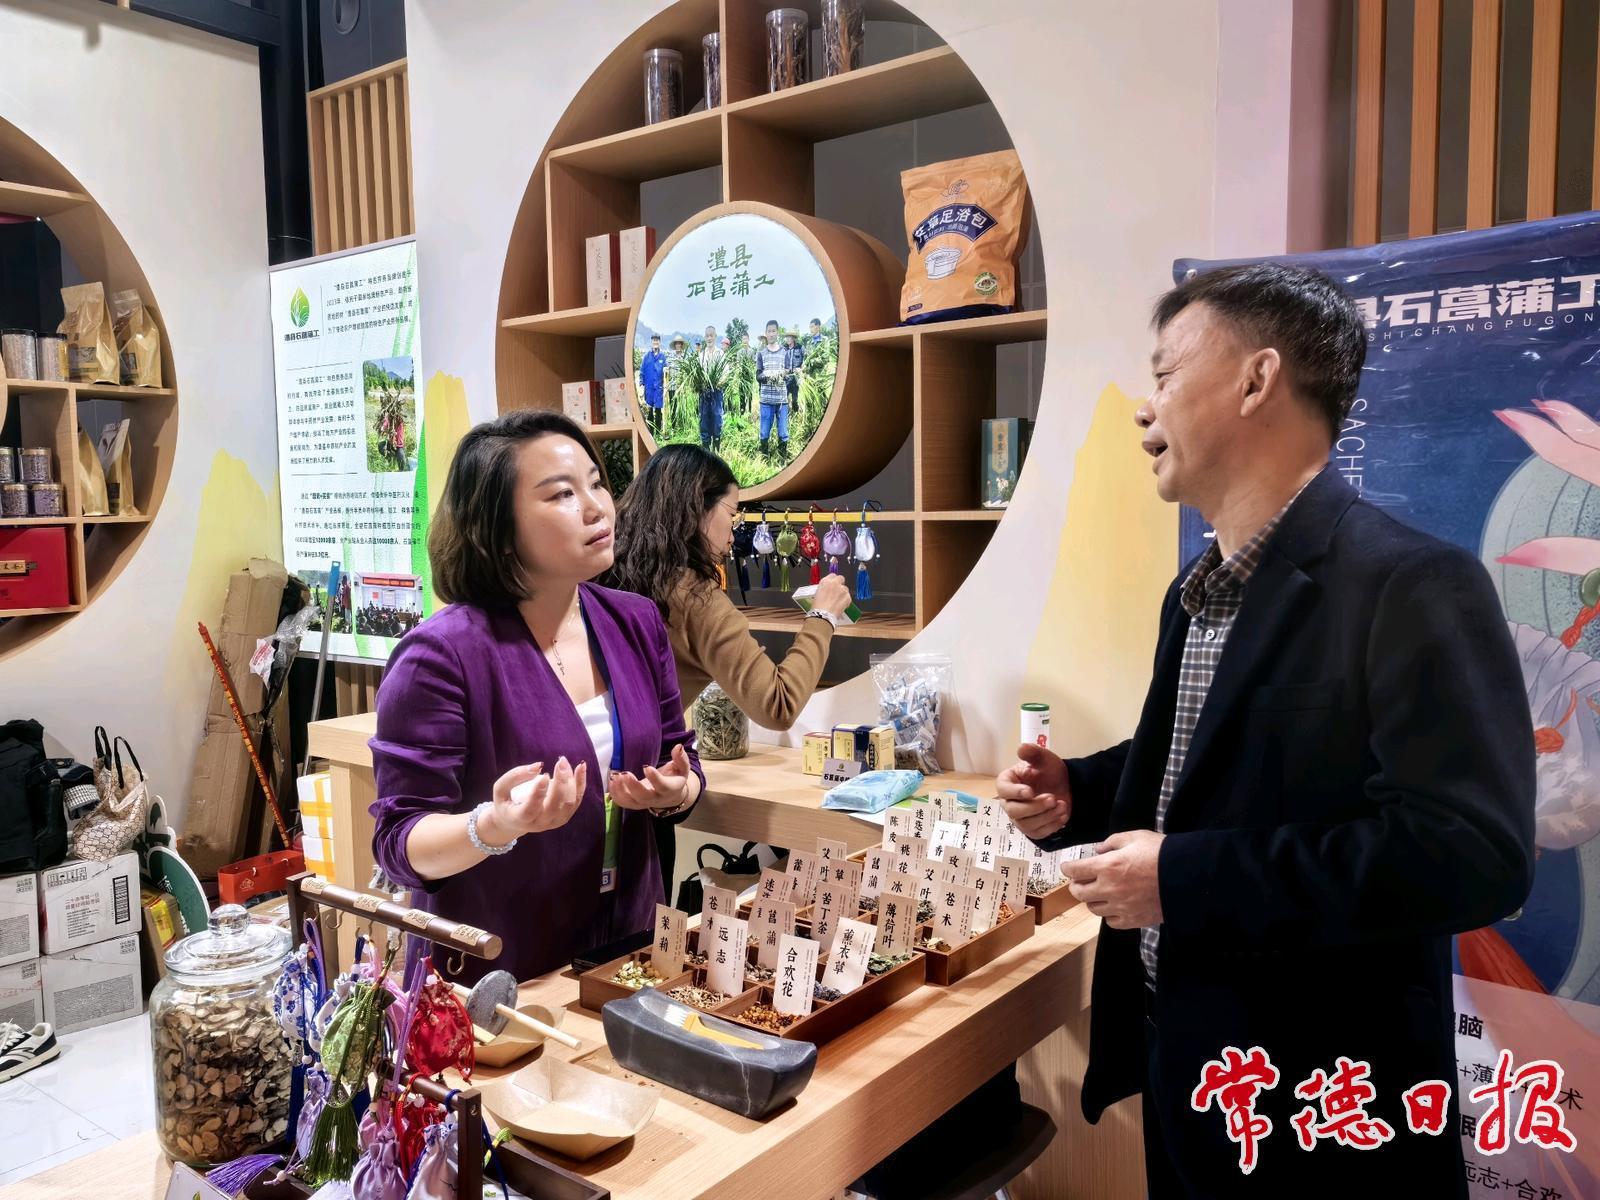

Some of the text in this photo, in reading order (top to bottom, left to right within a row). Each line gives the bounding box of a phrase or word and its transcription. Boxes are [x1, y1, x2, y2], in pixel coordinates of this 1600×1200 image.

[707, 243, 753, 272] 澧县
[686, 270, 775, 300] 石菖蒲工
[1336, 398, 1368, 498] SACHE
[889, 815, 899, 843] 陈皮
[935, 829, 949, 857] 丁香
[899, 843, 911, 874] 桃花
[980, 834, 992, 863] 白芷
[868, 857, 881, 889] 菖蒲
[919, 868, 935, 900] 艾叶
[817, 892, 832, 935] 苦丁茶
[882, 902, 897, 949] 薄荷叶
[941, 891, 956, 927] 苍术
[659, 915, 670, 952] 茉莉
[766, 909, 777, 946] 菖蒲
[715, 926, 729, 964] 远志
[833, 928, 855, 975] 薰衣草
[782, 947, 798, 998] 合欢花
[1454, 1012, 1484, 1040] 脑
